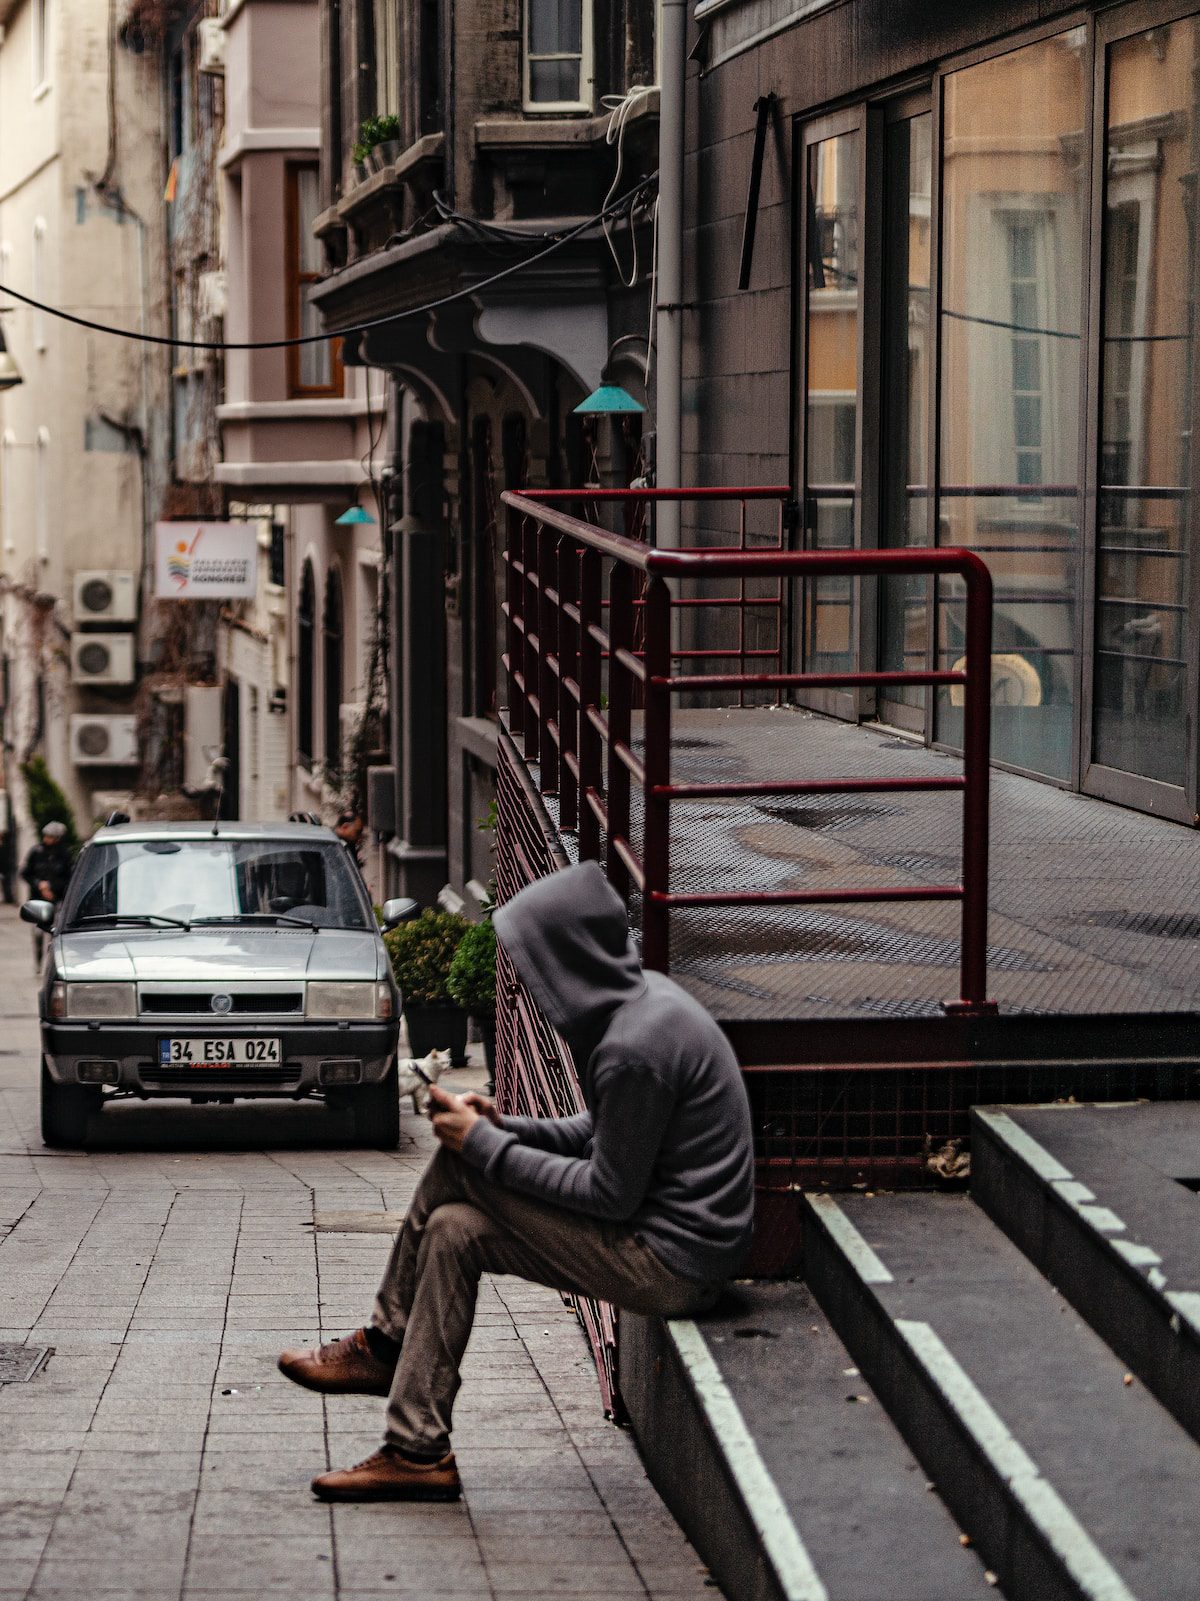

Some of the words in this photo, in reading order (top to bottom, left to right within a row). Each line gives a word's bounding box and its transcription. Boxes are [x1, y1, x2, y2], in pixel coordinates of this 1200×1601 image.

[171, 1041, 193, 1061] 34
[204, 1041, 235, 1061] ESA
[246, 1040, 278, 1060] 024
